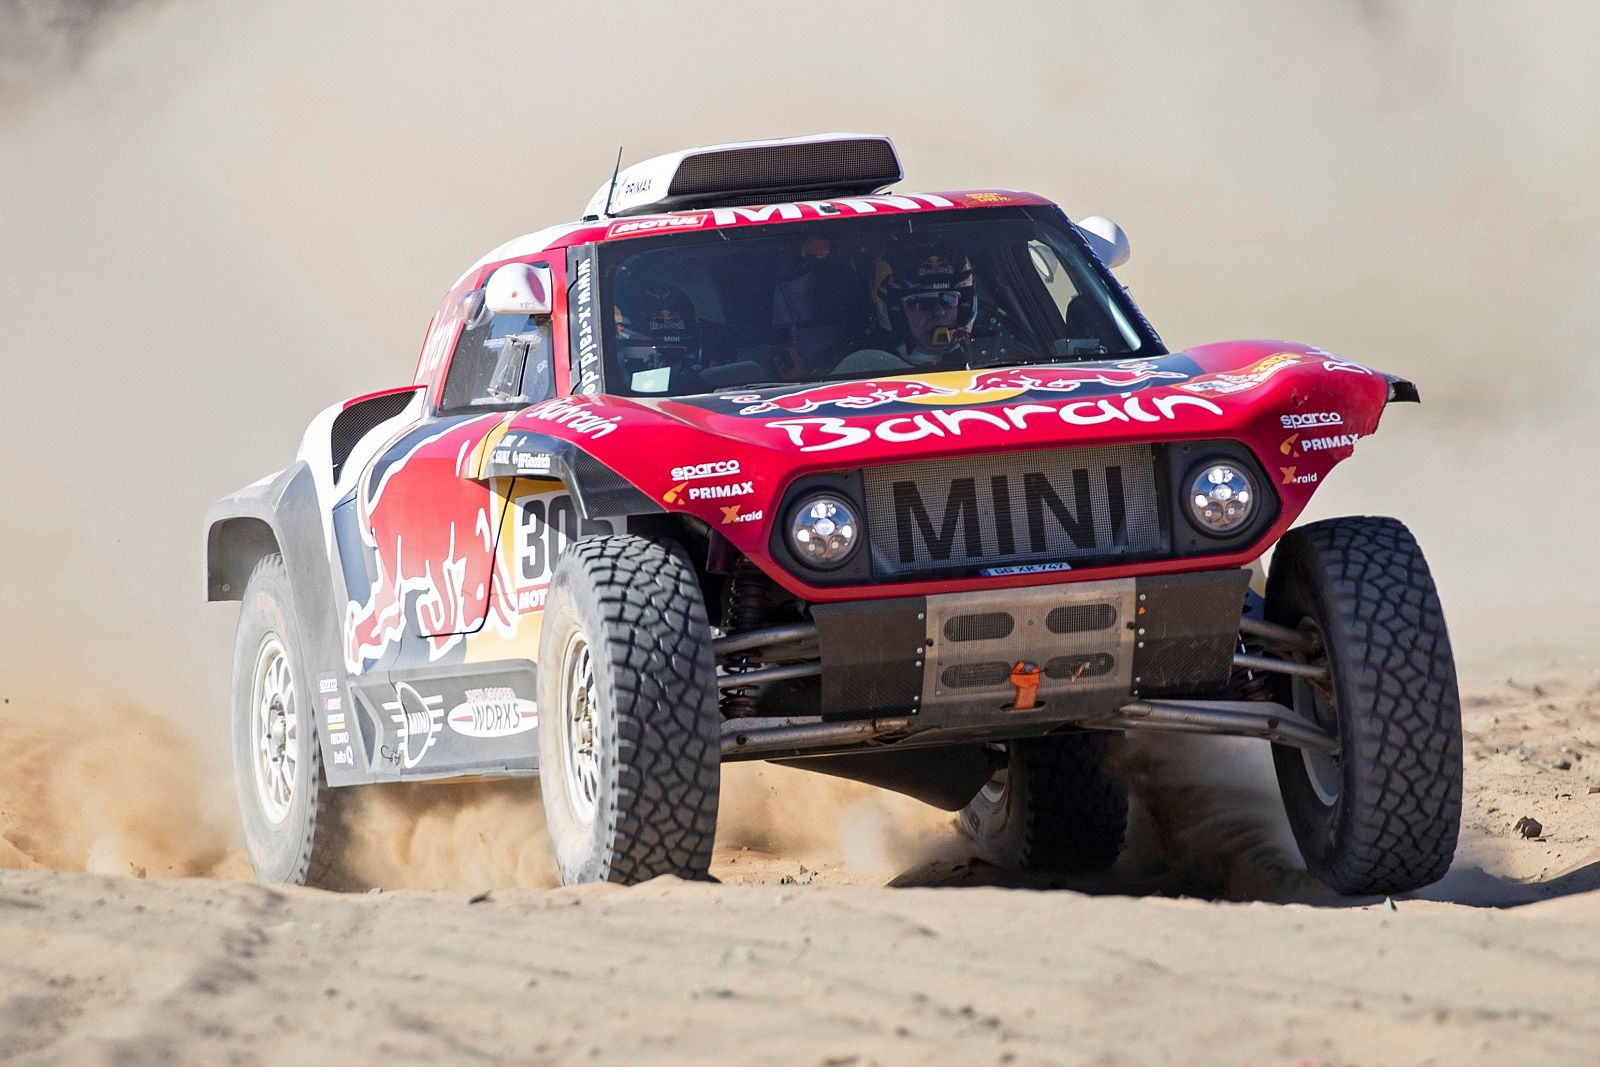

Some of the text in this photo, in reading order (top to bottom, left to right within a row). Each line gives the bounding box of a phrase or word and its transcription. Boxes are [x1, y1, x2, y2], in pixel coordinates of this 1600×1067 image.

[624, 179, 653, 195] PRIMAX
[714, 194, 954, 225] MINI
[615, 216, 699, 233] MOTUL
[578, 257, 600, 396] www.x-raid.de
[765, 392, 1223, 452] Bahrain
[1280, 412, 1342, 429] sparco
[1301, 433, 1358, 452] PRIMAX
[671, 460, 740, 480] sparco
[1280, 466, 1318, 484] X-raid
[688, 481, 754, 500] PRIMAX
[720, 504, 763, 524] X-raid
[893, 466, 1128, 562] MINI
[522, 494, 614, 579] 30
[994, 567, 1015, 575] GG
[519, 588, 549, 608] MOT
[407, 711, 430, 735] MINI
[472, 703, 521, 731] WORKS
